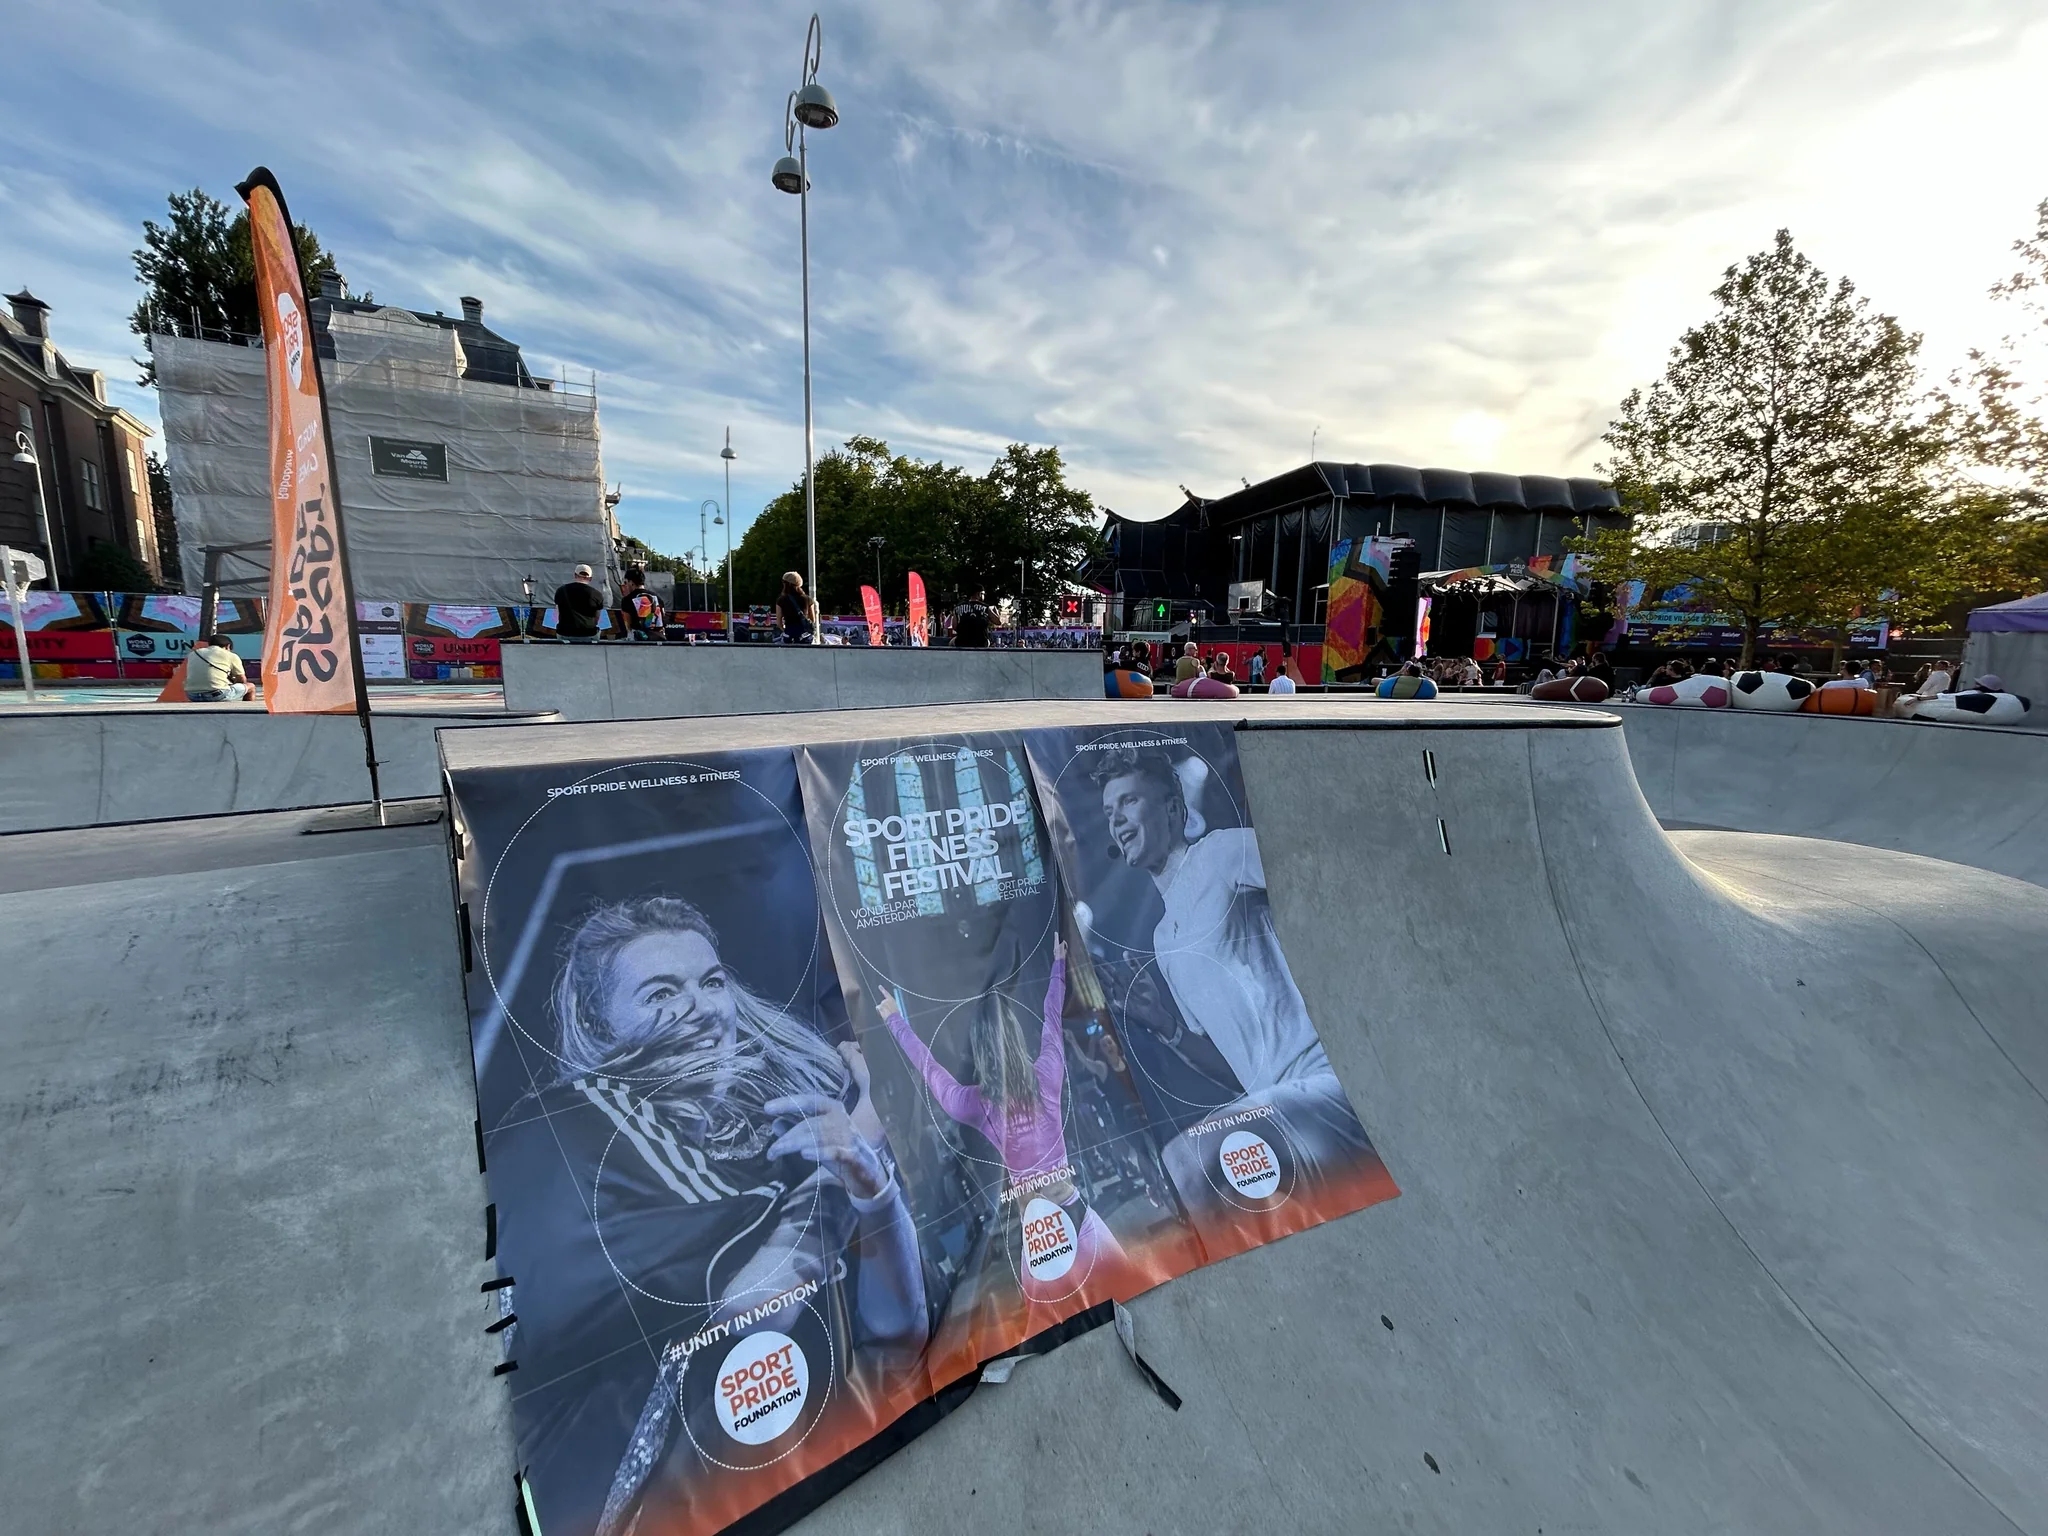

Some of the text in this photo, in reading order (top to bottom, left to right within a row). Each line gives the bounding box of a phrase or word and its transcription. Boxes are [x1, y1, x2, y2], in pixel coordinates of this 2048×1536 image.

[400, 458, 428, 466] Mourik
[443, 643, 490, 654] UNITY
[1075, 744, 1098, 752] SPORT
[1120, 740, 1155, 749] WELLNESS
[1162, 737, 1188, 746] FITNESS
[861, 757, 888, 767] SPORT
[915, 752, 956, 763] WELLNESS
[547, 770, 741, 798] SPORT PRIDE WELLNESS & FITNESS
[843, 800, 1029, 847] SPORT PRIDE
[887, 829, 999, 870] FITNESS
[883, 855, 1013, 900] FESTIVAL
[1017, 874, 1047, 886] PRIDE
[999, 886, 1041, 901] FESTIVAL
[856, 909, 922, 929] AMSTERDAM
[1187, 1105, 1275, 1138] #UNITY IN MOTION
[1223, 1142, 1267, 1167] SPORT
[1230, 1156, 1273, 1179] PRIDE
[1000, 1183, 1026, 1204] #UNITY
[1034, 1165, 1076, 1190] MOTION
[1236, 1169, 1277, 1189] FOUNDATION
[1024, 1210, 1062, 1241] SPORT
[1027, 1227, 1069, 1258] PRIDE
[1029, 1243, 1073, 1269] FOUNDATION
[670, 1279, 819, 1362] #UNITY IN MOTION
[720, 1343, 793, 1397] SPORT
[729, 1366, 798, 1417] PRIDE
[733, 1387, 802, 1432] FOUNDATION
